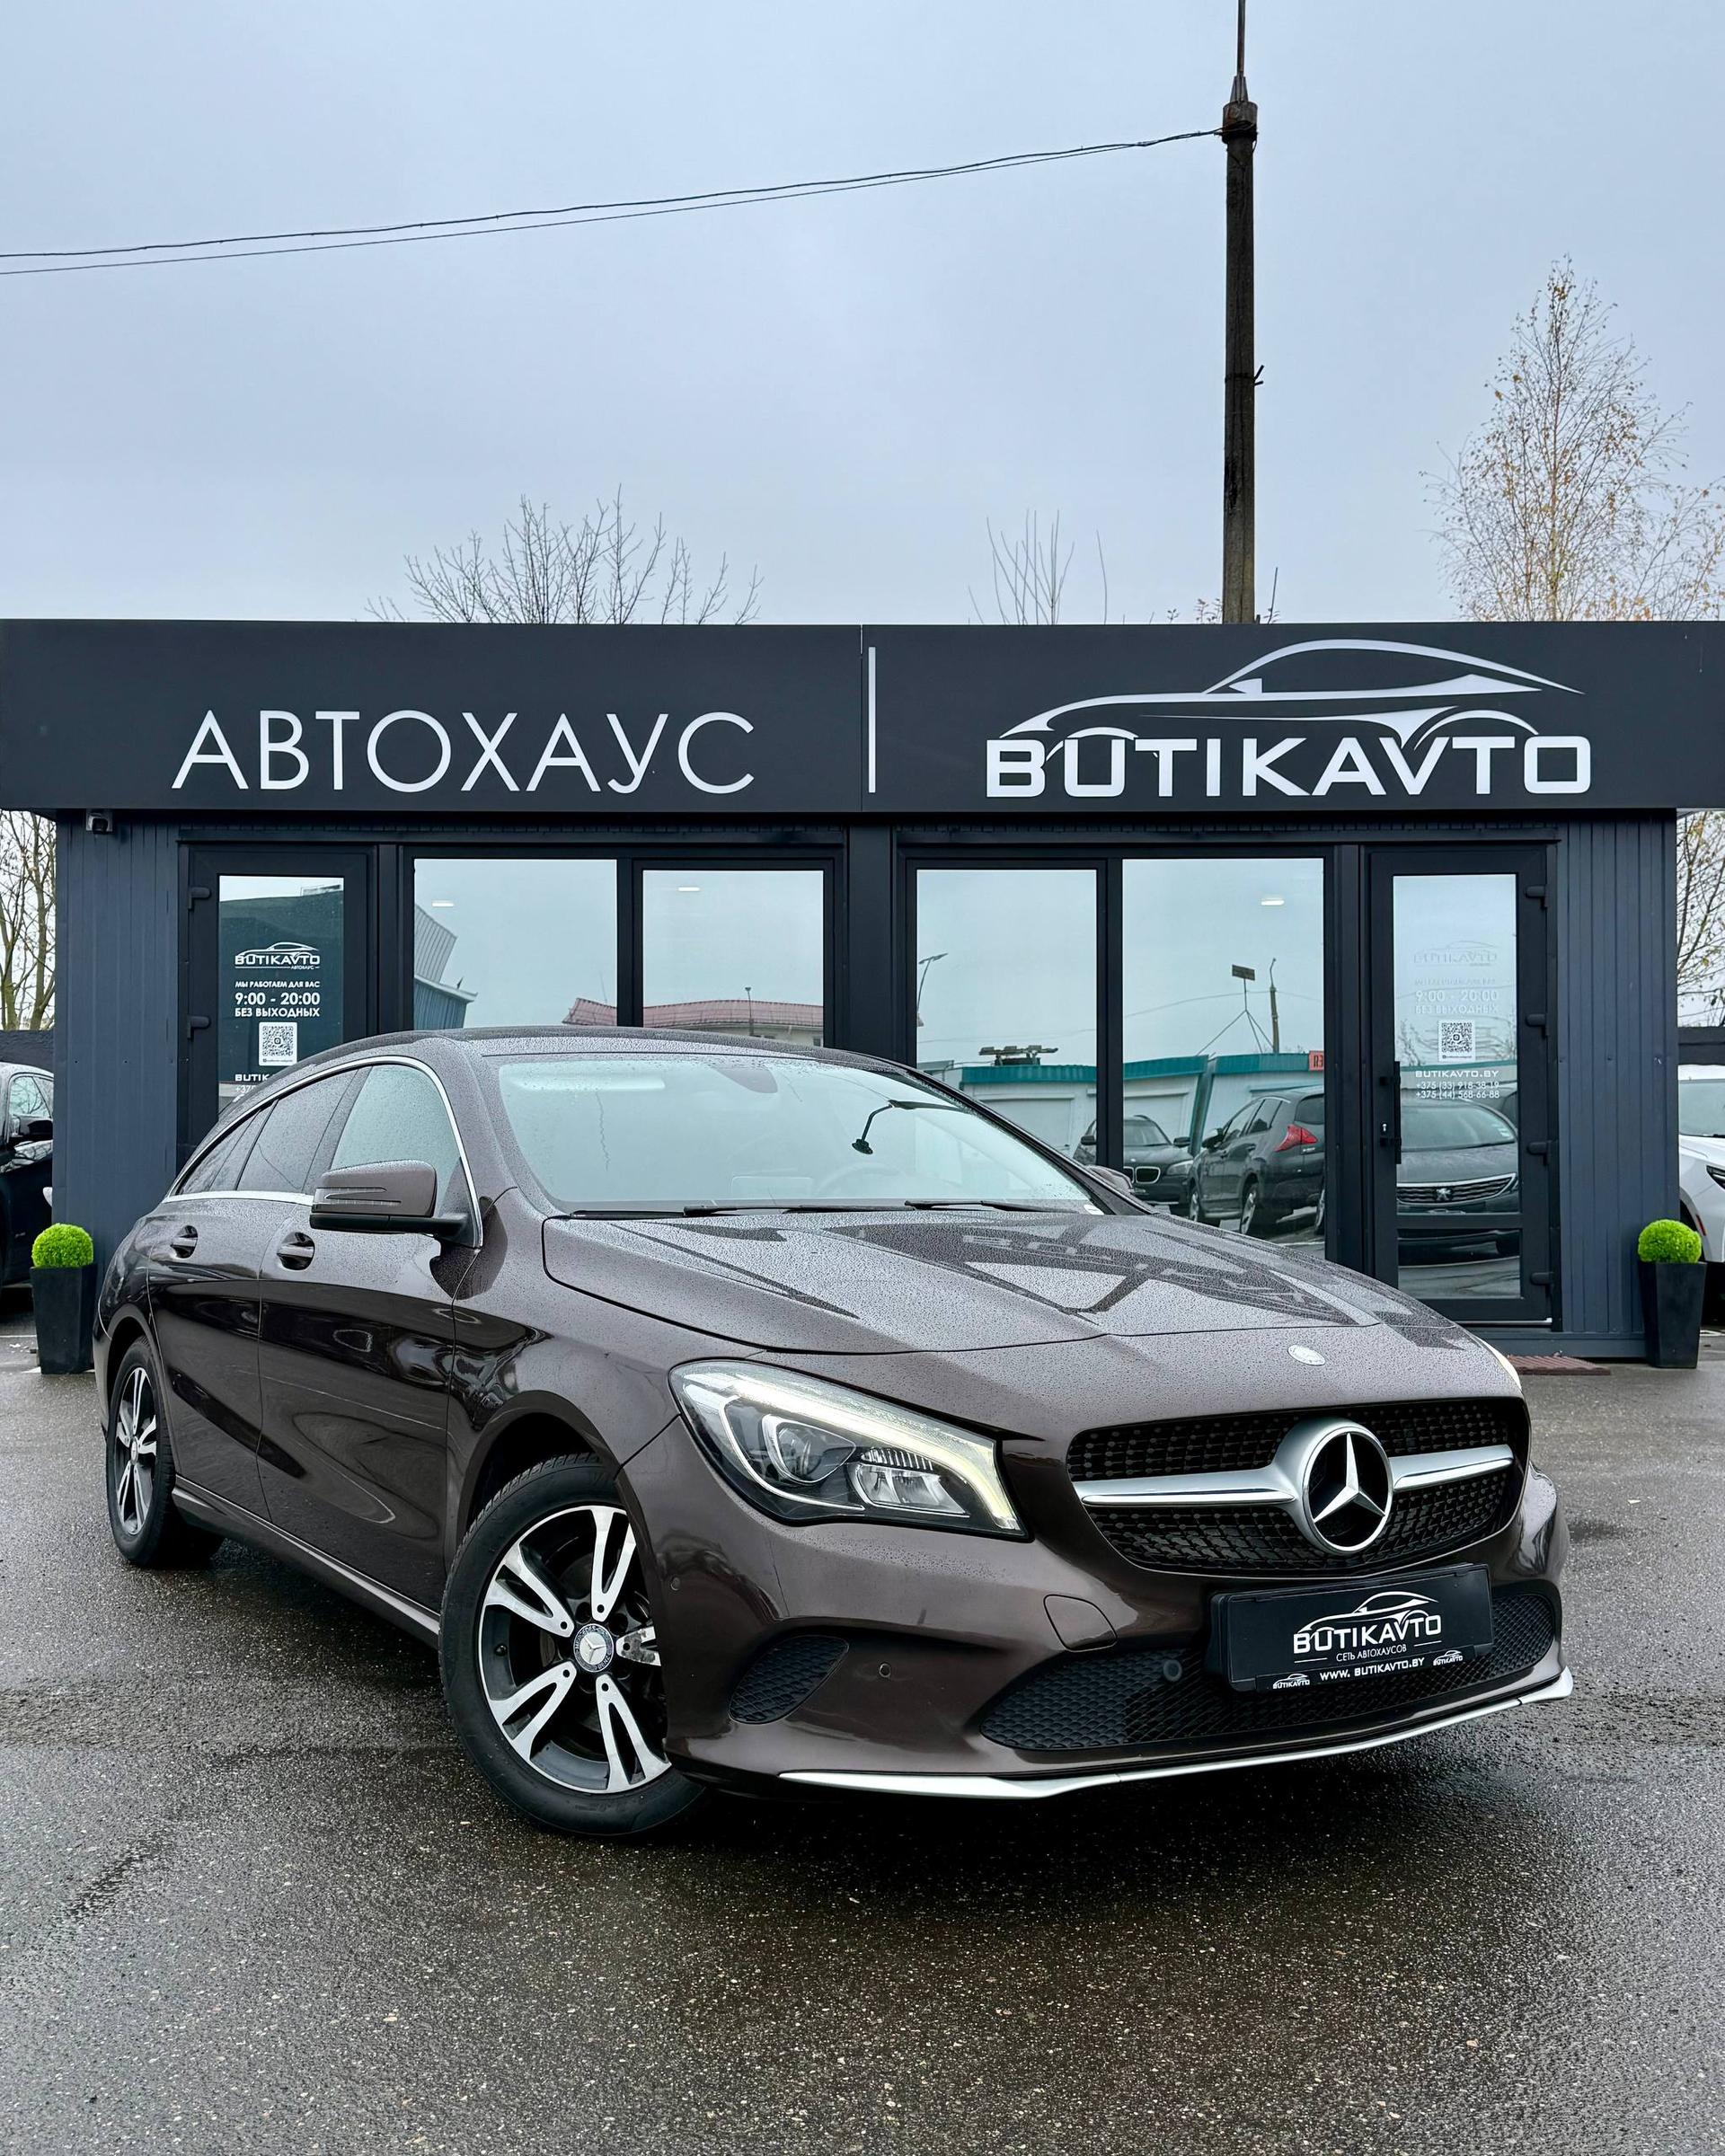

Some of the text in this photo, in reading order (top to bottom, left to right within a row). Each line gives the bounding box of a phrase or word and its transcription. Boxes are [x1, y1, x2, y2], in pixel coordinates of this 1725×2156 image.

[171, 710, 756, 795] АВТОХАУС
[986, 735, 1592, 798] BUTIKAVTO
[234, 955, 321, 966] BUTIKAVTO
[234, 980, 321, 988] МЫ РАБОТАЕМ ДЛЯ ВАС
[234, 992, 266, 1005] 9:00
[279, 992, 321, 1005] 20:00
[1415, 989, 1446, 1003] 9:00
[1460, 989, 1499, 1003] 20:00
[234, 1007, 321, 1019] БЕЗ ВЫХОДНЫХ
[1414, 1070, 1500, 1078] BUTIKAVTO.BY
[1416, 1090, 1437, 1099] +375
[1293, 1614, 1442, 1655] BUTIKAVTO
[1336, 1644, 1407, 1662] СЕТЬ АВТОХАУСОВ
[1319, 1657, 1425, 1682] WWW. BUTIKAVTO.BY
